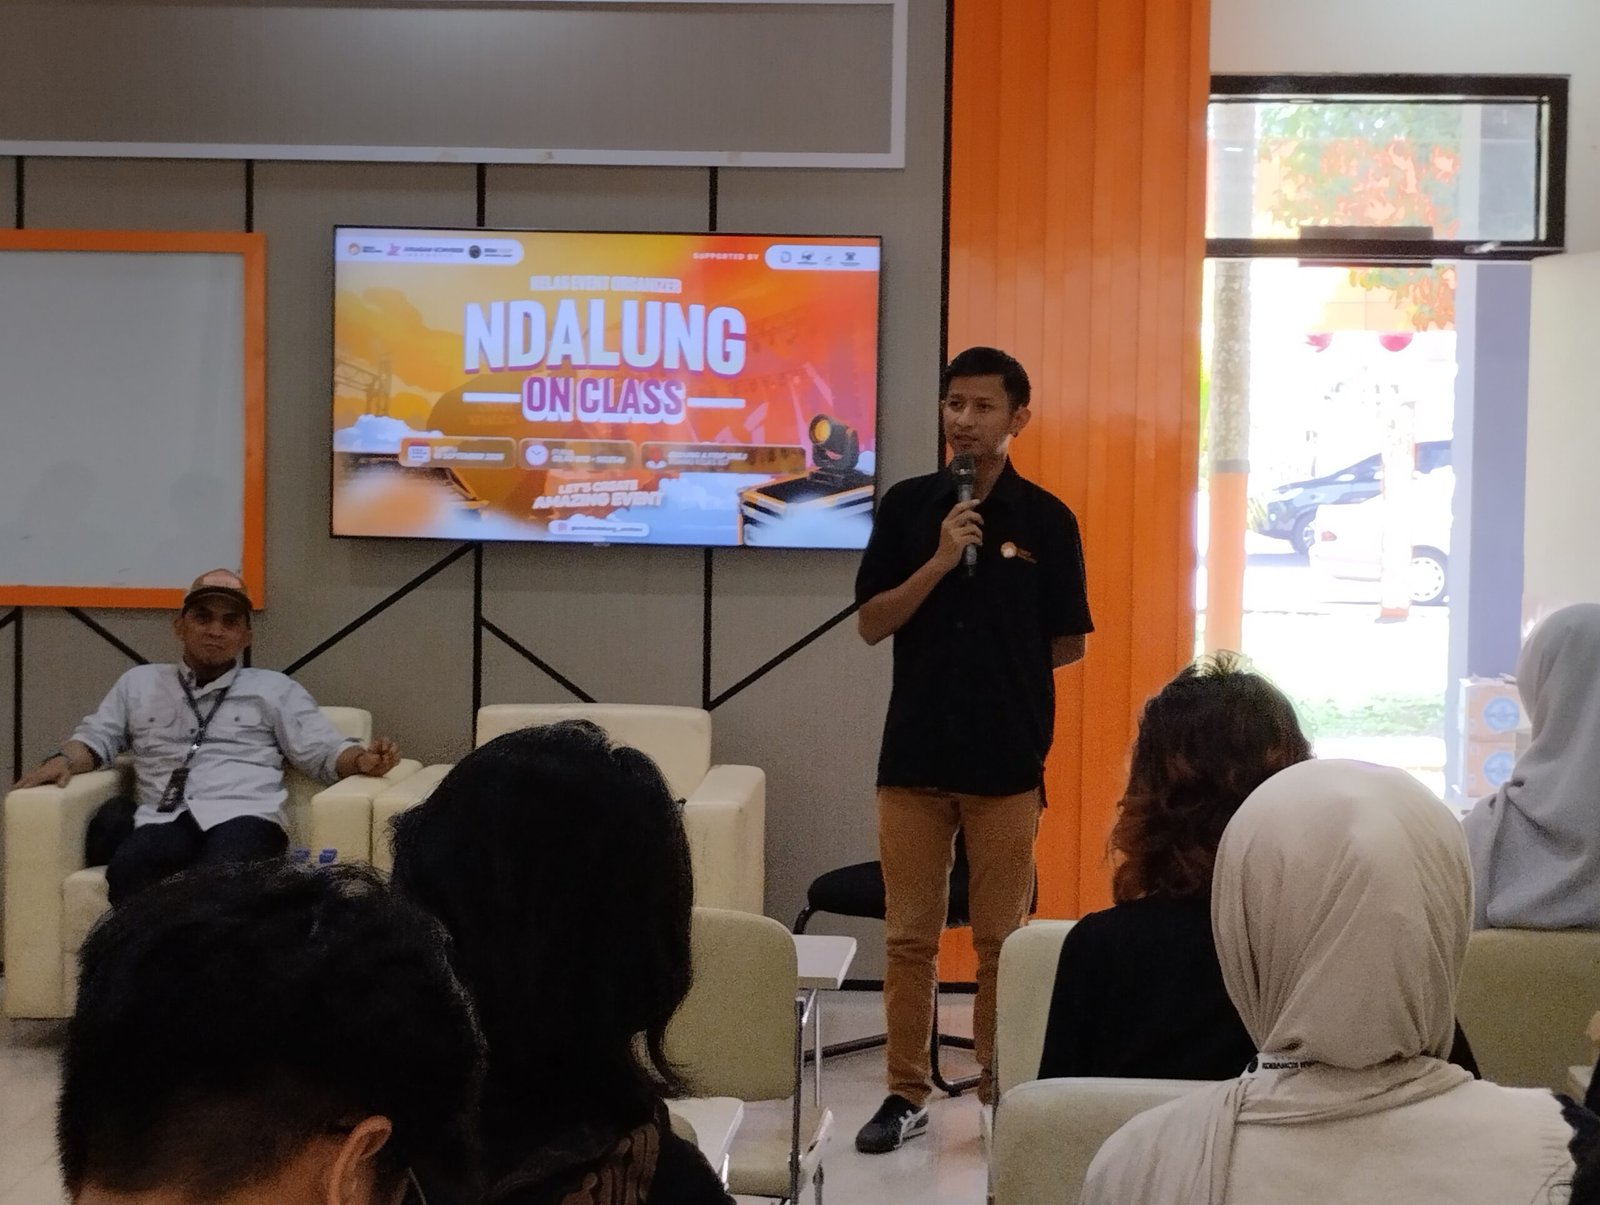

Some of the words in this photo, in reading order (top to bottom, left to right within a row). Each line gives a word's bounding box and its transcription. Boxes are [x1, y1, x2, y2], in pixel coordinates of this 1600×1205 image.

[464, 299, 747, 378] NDALUNG
[522, 376, 574, 422] ON
[576, 377, 687, 424] CLASS
[532, 492, 611, 509] AMAZING
[610, 491, 663, 507] EVENT
